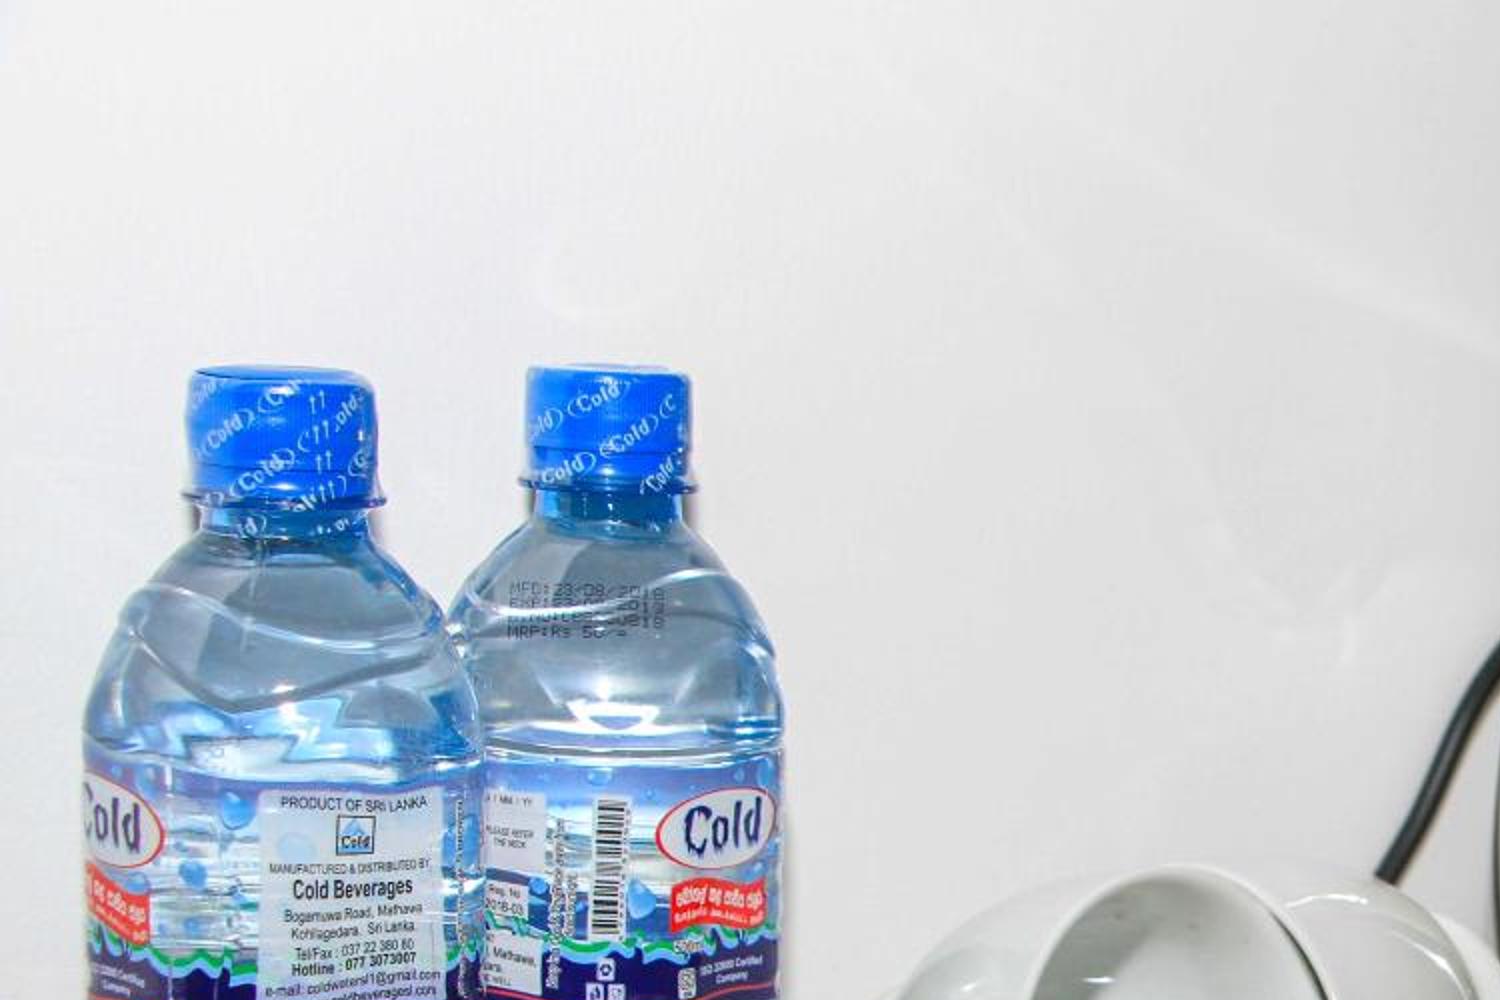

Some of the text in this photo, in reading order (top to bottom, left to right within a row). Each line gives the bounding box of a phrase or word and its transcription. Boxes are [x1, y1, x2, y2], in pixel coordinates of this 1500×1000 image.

[281, 795, 429, 812] PRODUCT OF SRI LANKA
[684, 796, 763, 857] Cold
[269, 862, 348, 875] MANUFACTURED
[358, 859, 417, 874] DISTRIBUTED
[418, 857, 431, 869] BY
[293, 877, 414, 900] Cold Beverages
[367, 921, 384, 935] Sri
[385, 920, 416, 934] Lanka
[291, 963, 335, 977] Hotline
[345, 956, 366, 971] 077
